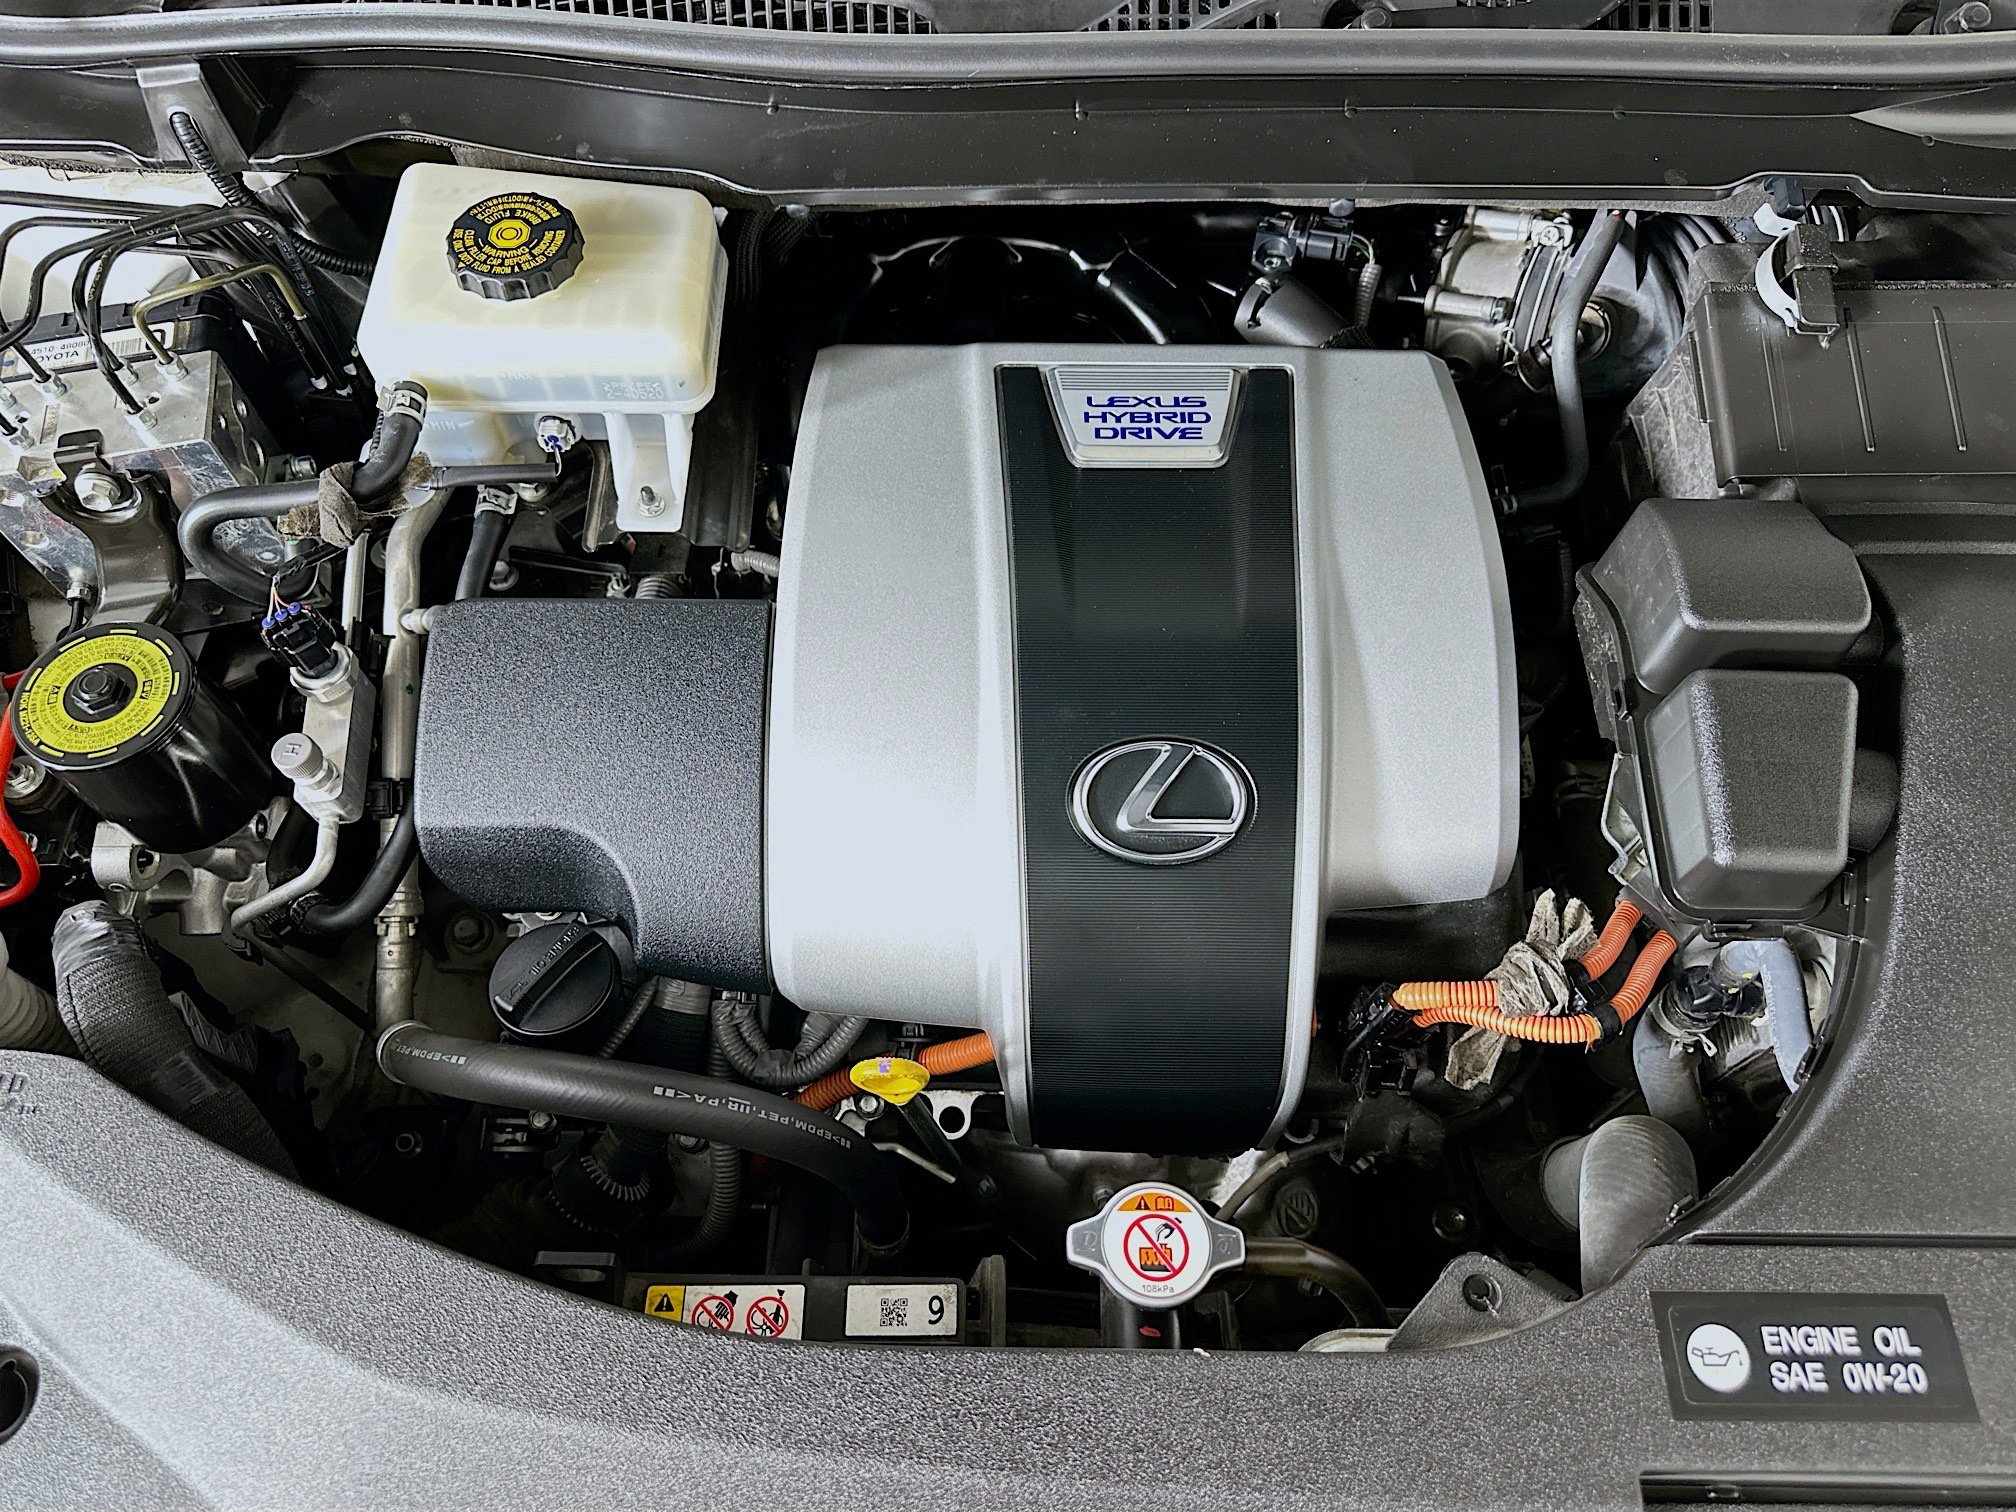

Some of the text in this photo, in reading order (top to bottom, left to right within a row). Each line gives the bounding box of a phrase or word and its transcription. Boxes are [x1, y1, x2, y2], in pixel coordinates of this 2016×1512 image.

[484, 209, 510, 225] FLUID
[515, 209, 541, 225] BRAKE
[468, 246, 487, 262] FILLER
[487, 257, 502, 266] CAP
[504, 255, 533, 266] BEFORE
[482, 245, 529, 259] WARNING
[471, 261, 490, 273] FLUID
[491, 267, 511, 275] FROM
[514, 265, 520, 273] A
[521, 255, 547, 271] SEALED
[27, 340, 90, 356] 4510-48080
[36, 350, 79, 363] OYOTA
[1086, 396, 1207, 408] LEXUS
[1083, 411, 1212, 424] HYBRID
[1094, 427, 1203, 440] DRIVE
[529, 959, 547, 976] OIL
[1142, 1284, 1175, 1294] 108kPa
[928, 1294, 945, 1325] 9
[1760, 1325, 1923, 1358] ENGINE OIL
[1769, 1361, 1929, 1394] SAE 0W-20
